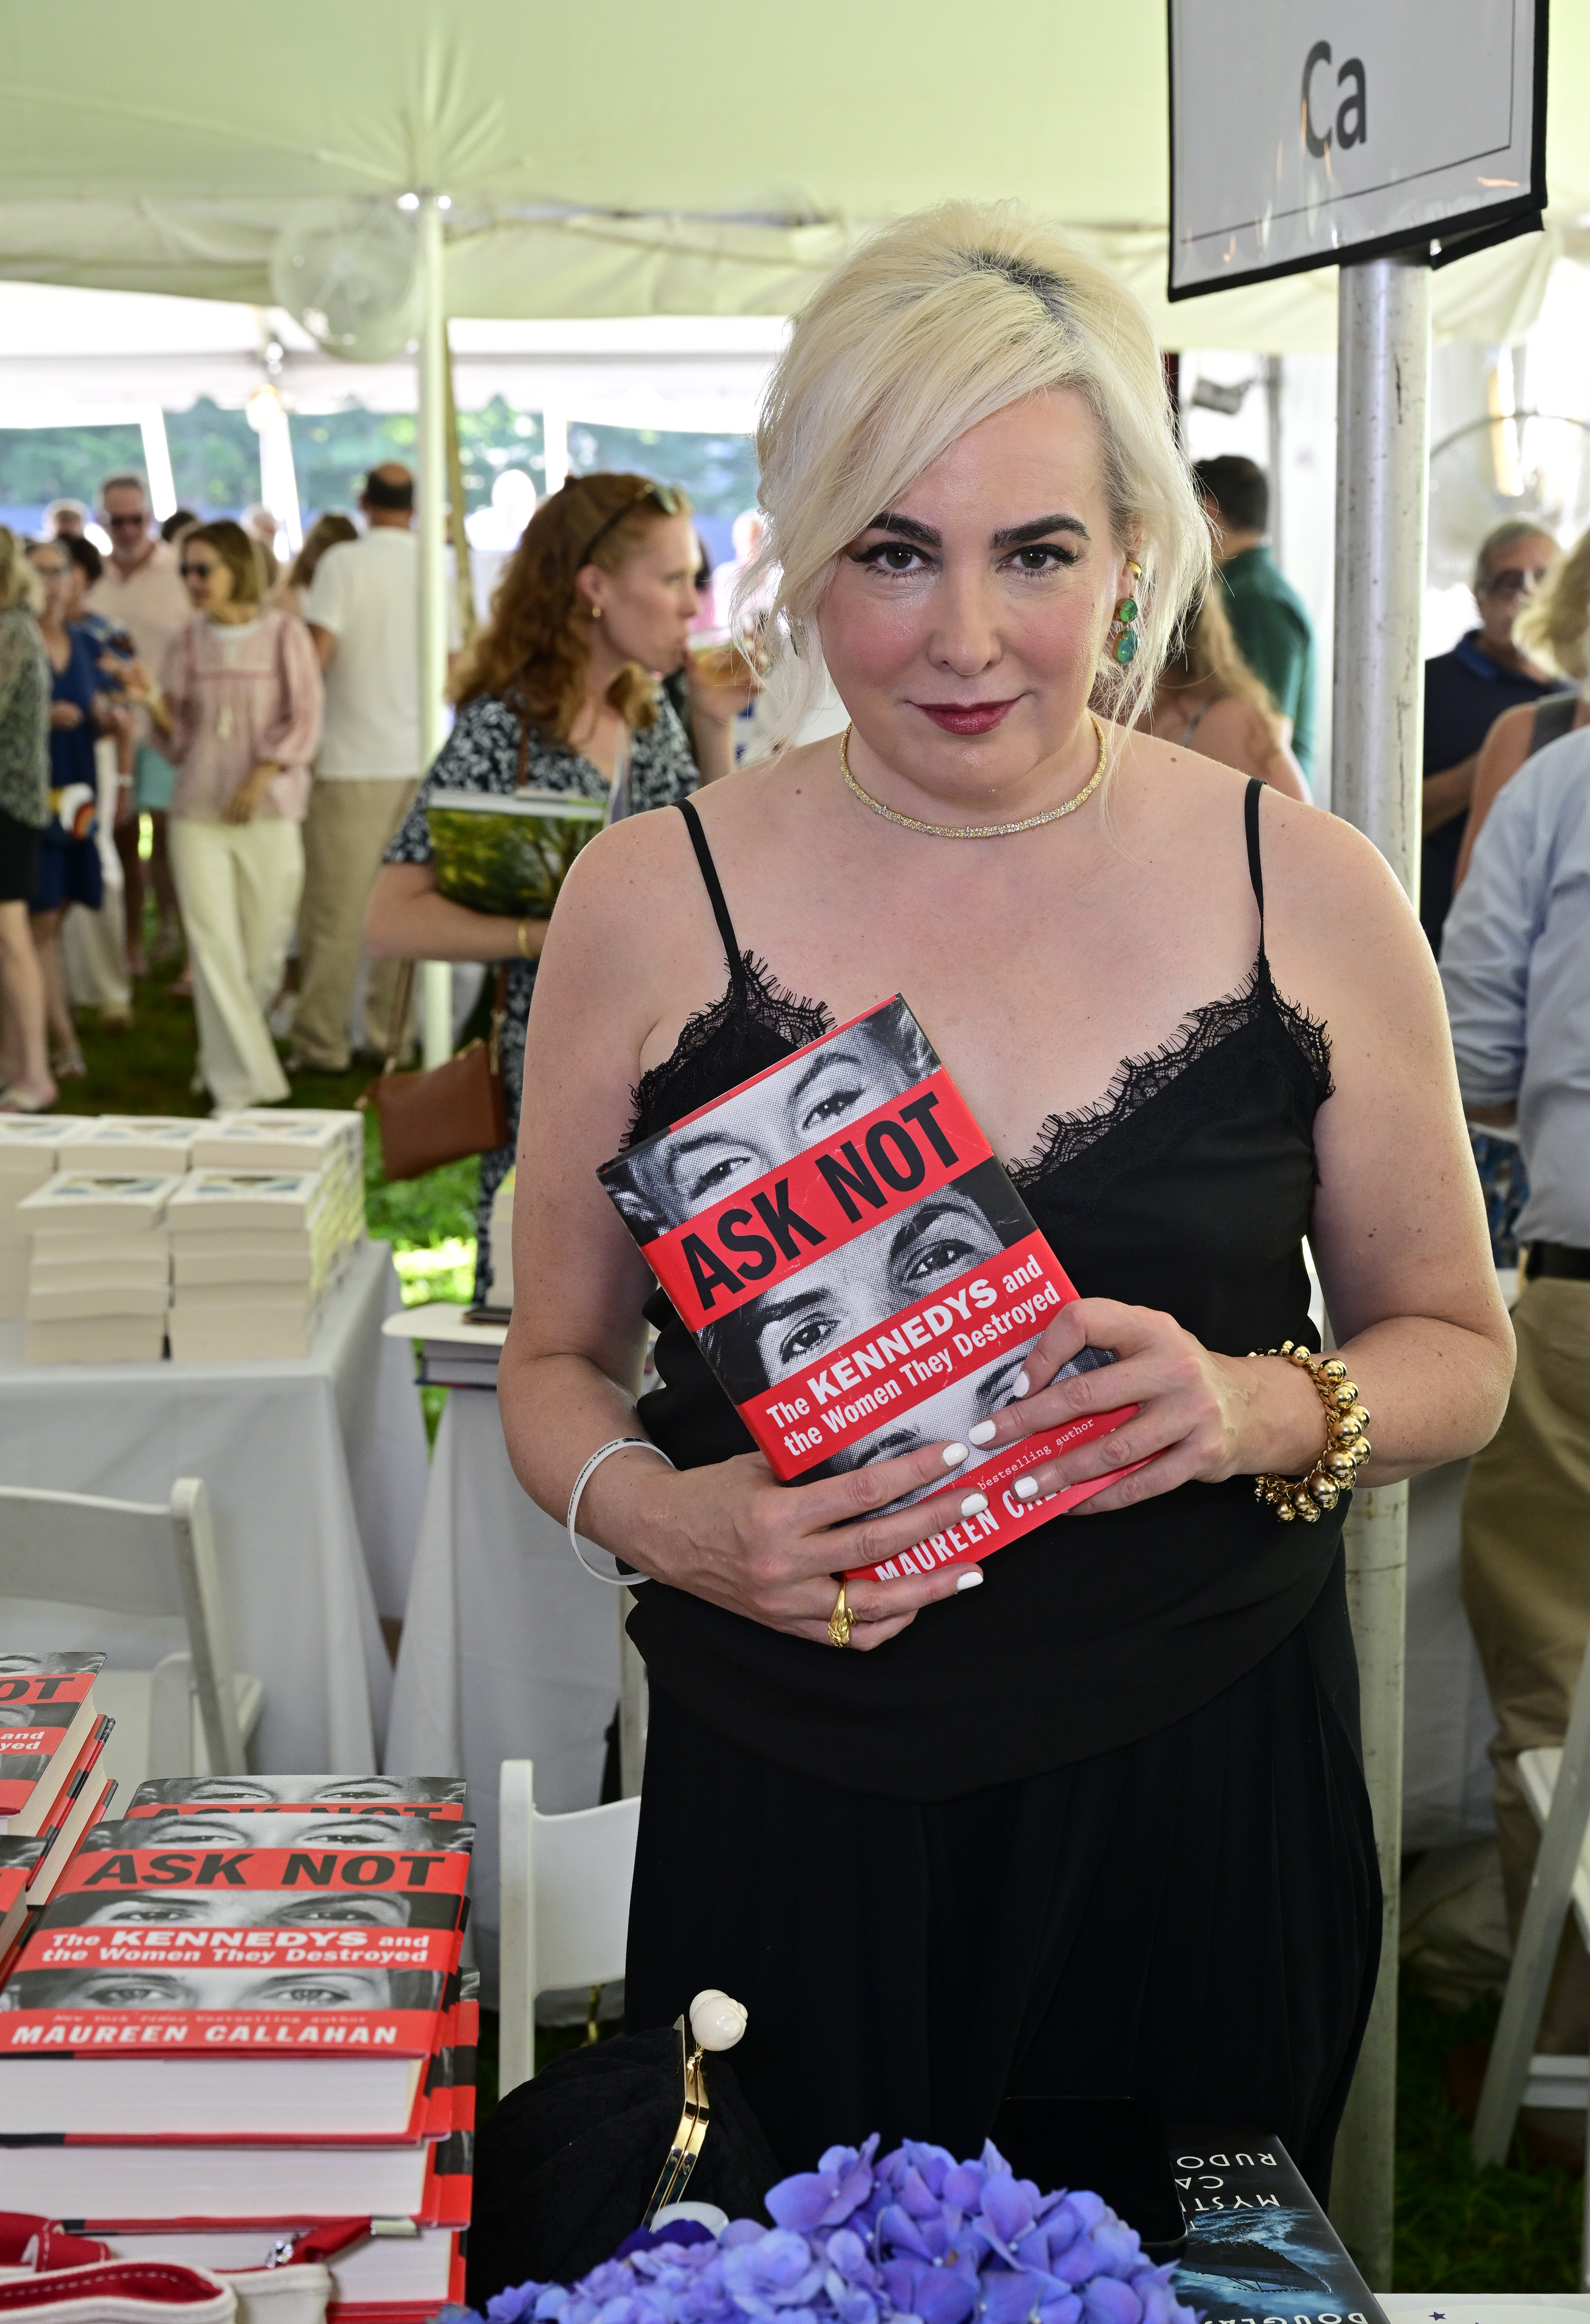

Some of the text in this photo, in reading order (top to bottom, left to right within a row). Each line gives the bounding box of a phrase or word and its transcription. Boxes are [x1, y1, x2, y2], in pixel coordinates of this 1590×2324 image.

[1302, 40, 1367, 159] Ca
[680, 1091, 959, 1310] ASK NOT
[766, 1254, 1043, 1429] The KENNEDYS and
[784, 1281, 1060, 1457] the Women They Destroyed
[977, 1444, 1051, 1490] bestselling
[1056, 1418, 1094, 1446] author
[573, 1461, 593, 1495] Hampton
[593, 1441, 619, 1460] Library
[0, 1677, 76, 1702] OT
[0, 1731, 45, 1740] and
[82, 1853, 446, 1887] ASK NOT
[52, 1930, 430, 1948] The KENNEDYS and
[42, 1948, 429, 1964] the Women They Destroyed
[10, 2025, 397, 2045] MAUREEN CALLAHAN
[1176, 2153, 1277, 2169] RUDO
[1175, 2176, 1224, 2190] CA
[1181, 2194, 1281, 2212] MYST
